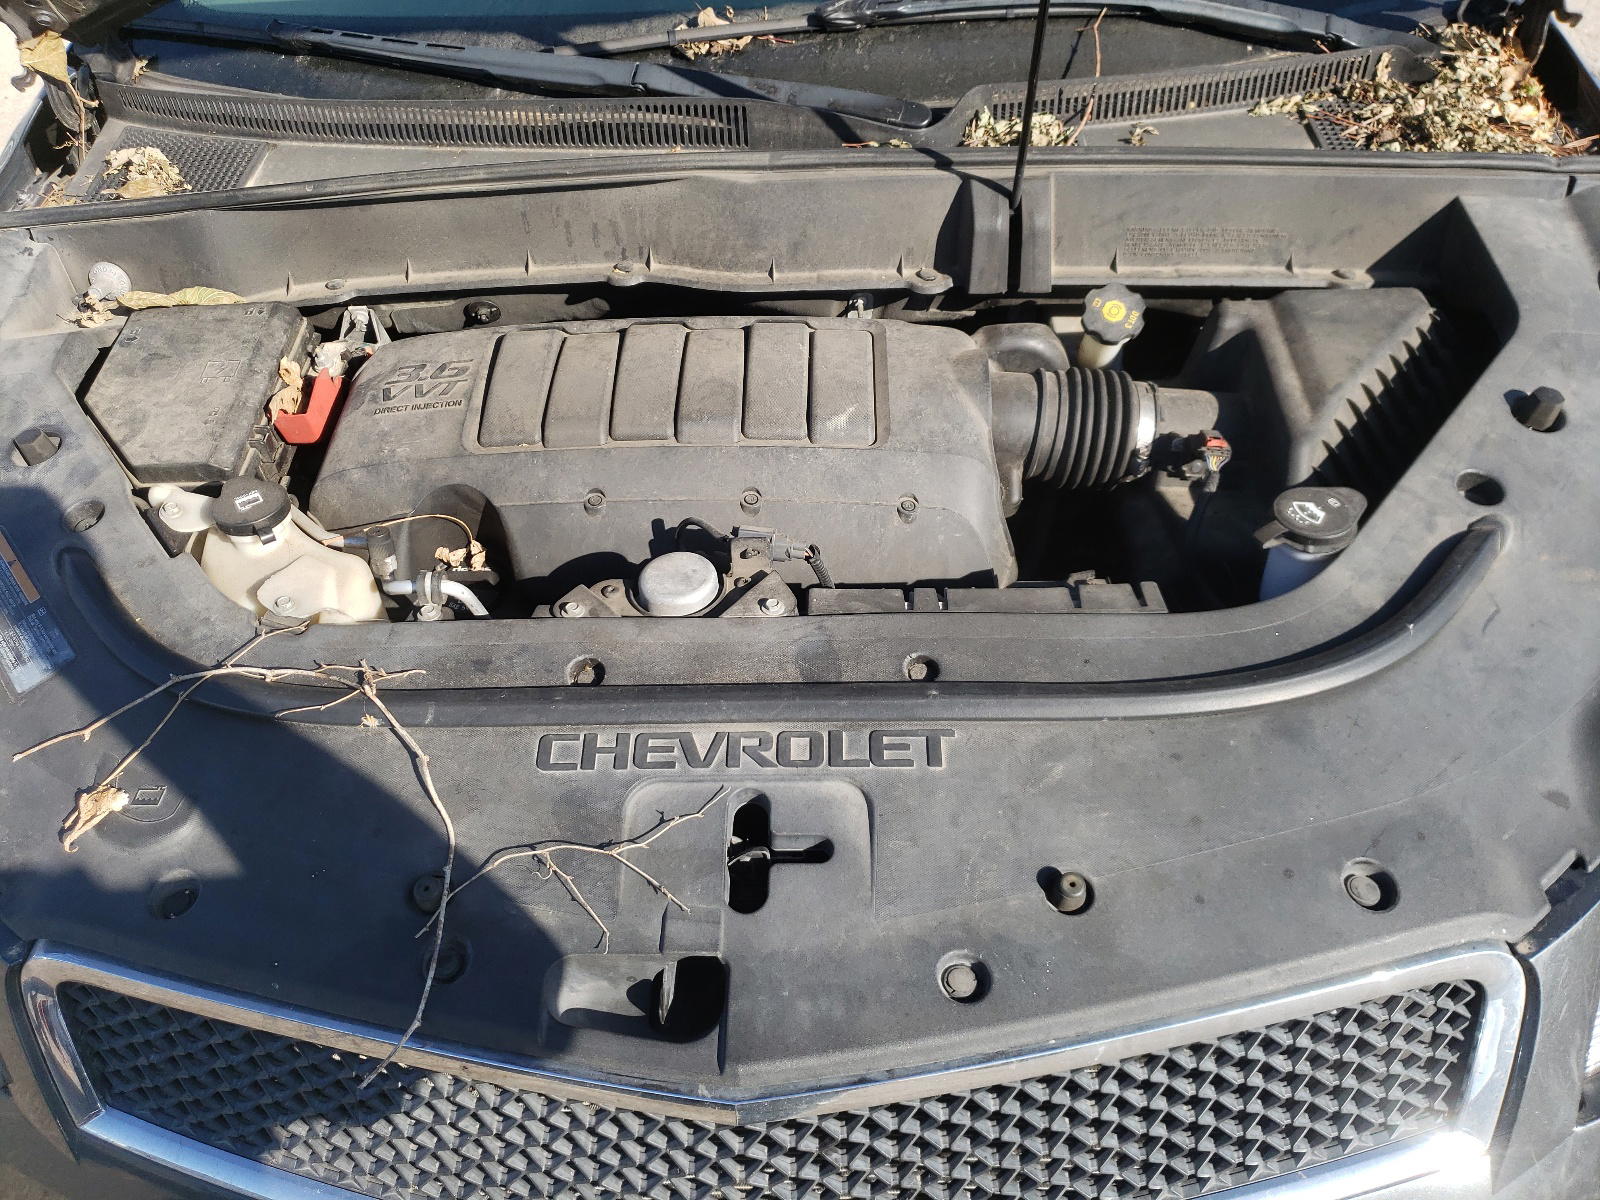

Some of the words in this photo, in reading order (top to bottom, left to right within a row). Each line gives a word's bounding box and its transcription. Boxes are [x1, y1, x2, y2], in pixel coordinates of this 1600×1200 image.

[384, 359, 474, 385] 3.6
[382, 379, 469, 402] VVT
[373, 404, 410, 416] DIRECT
[411, 399, 463, 411] INJECTION
[535, 728, 956, 771] CHEVROLET
